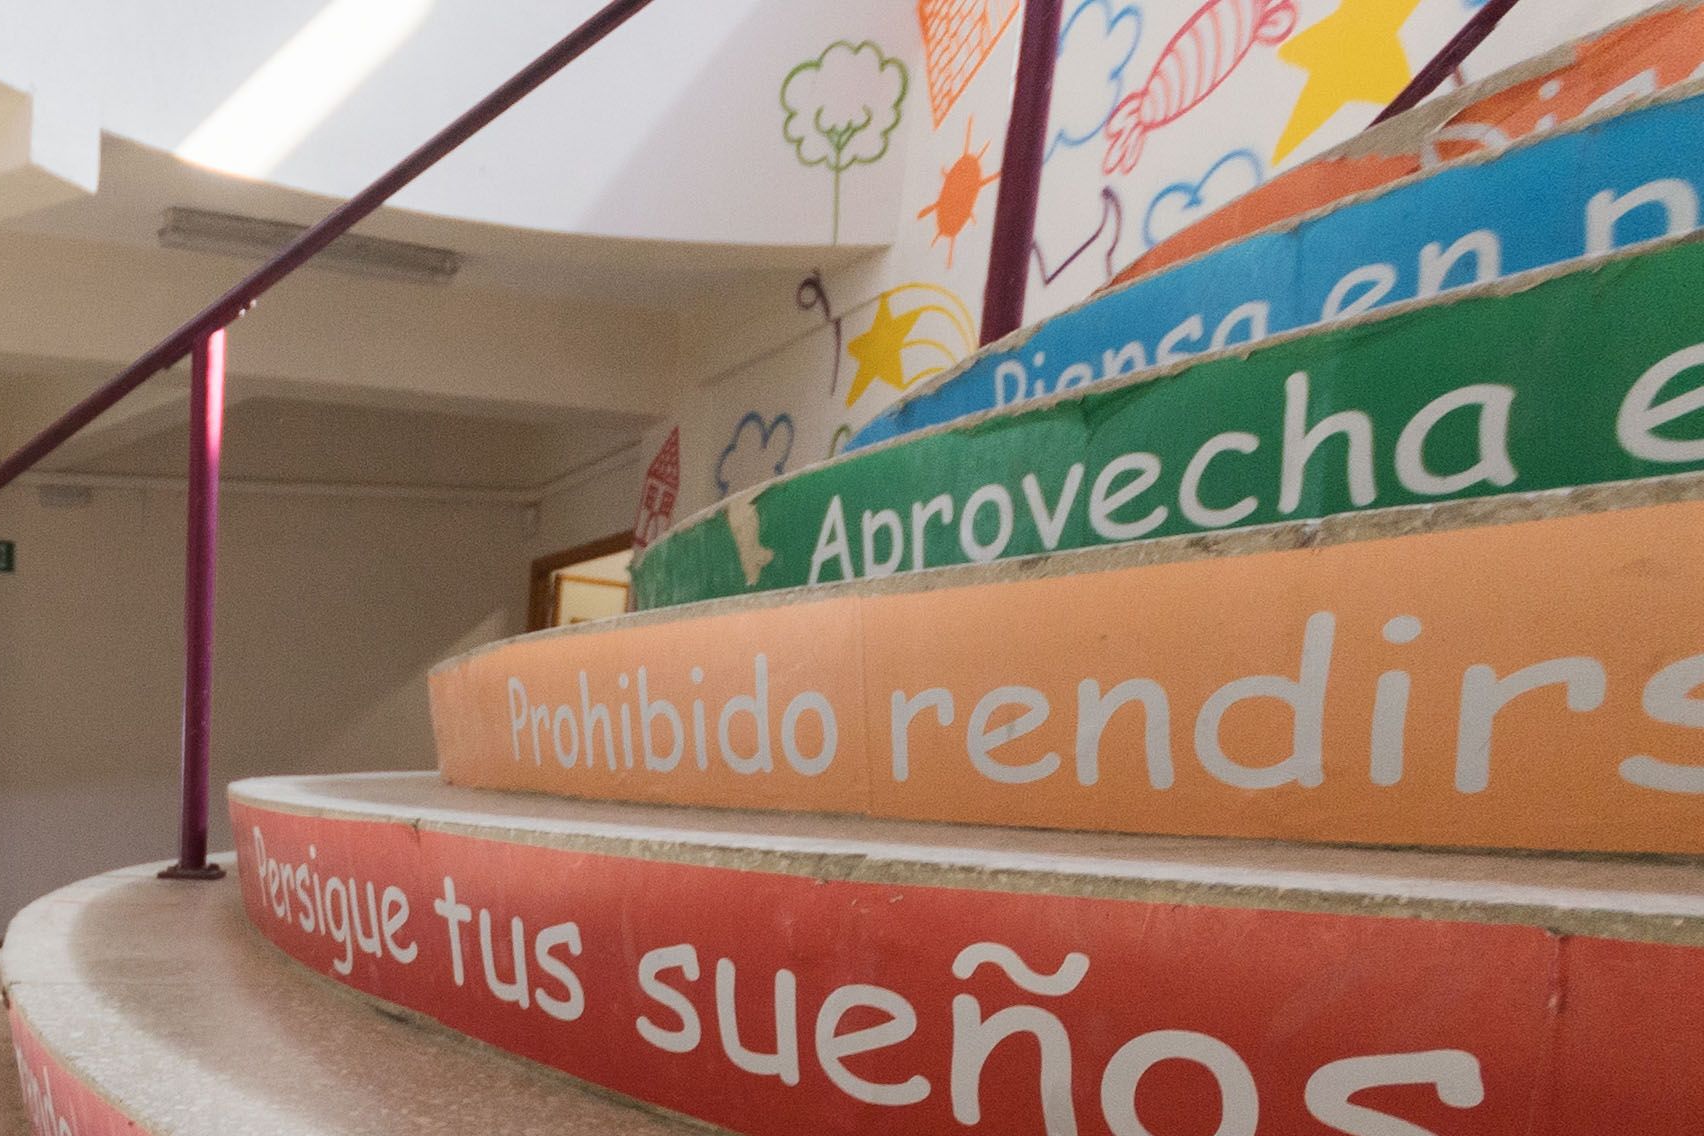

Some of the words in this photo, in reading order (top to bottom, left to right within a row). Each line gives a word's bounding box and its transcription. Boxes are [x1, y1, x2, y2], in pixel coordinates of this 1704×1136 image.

[1321, 229, 1503, 323] en
[807, 371, 1518, 586] Aprovecha
[507, 652, 839, 777] Prohibido
[253, 826, 418, 976] Persigue
[434, 875, 585, 1022] tus
